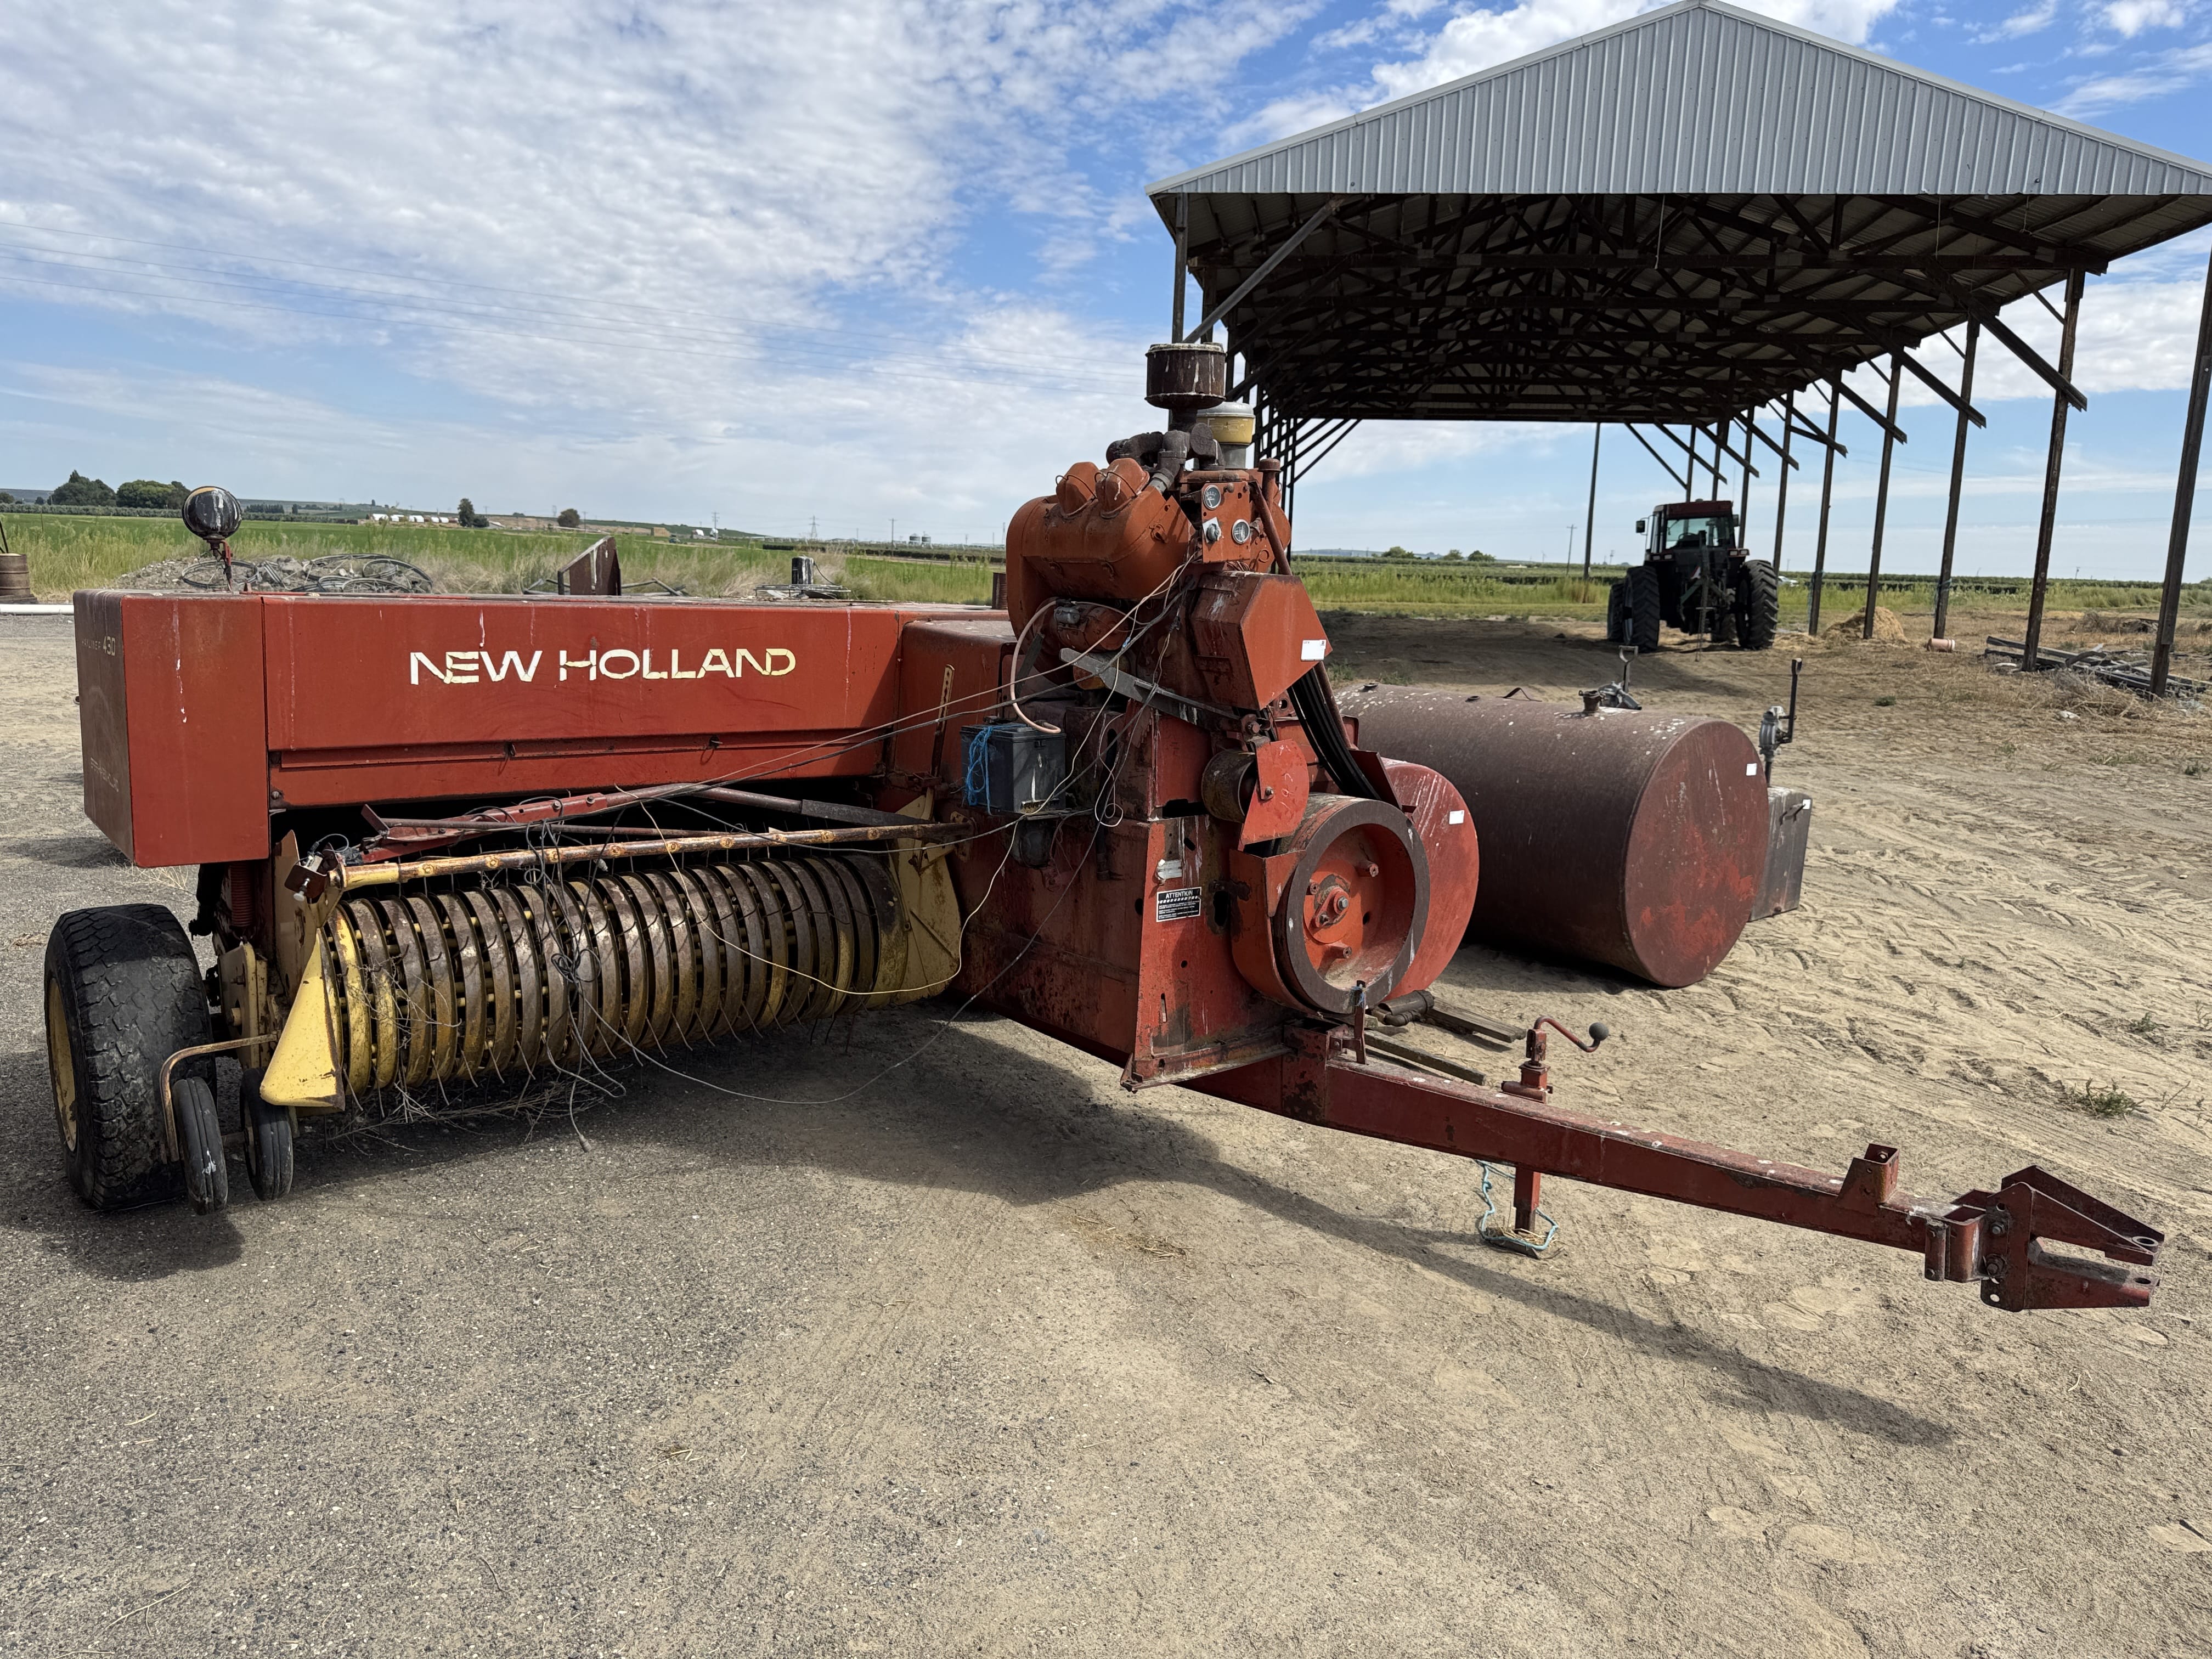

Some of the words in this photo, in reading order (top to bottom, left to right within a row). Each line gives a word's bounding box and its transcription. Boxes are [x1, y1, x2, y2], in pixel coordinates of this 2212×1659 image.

[103, 636, 116, 656] 430
[410, 650, 543, 685] NEW
[559, 648, 796, 681] HOLLAND
[1165, 889, 1193, 899] ATTENTION
